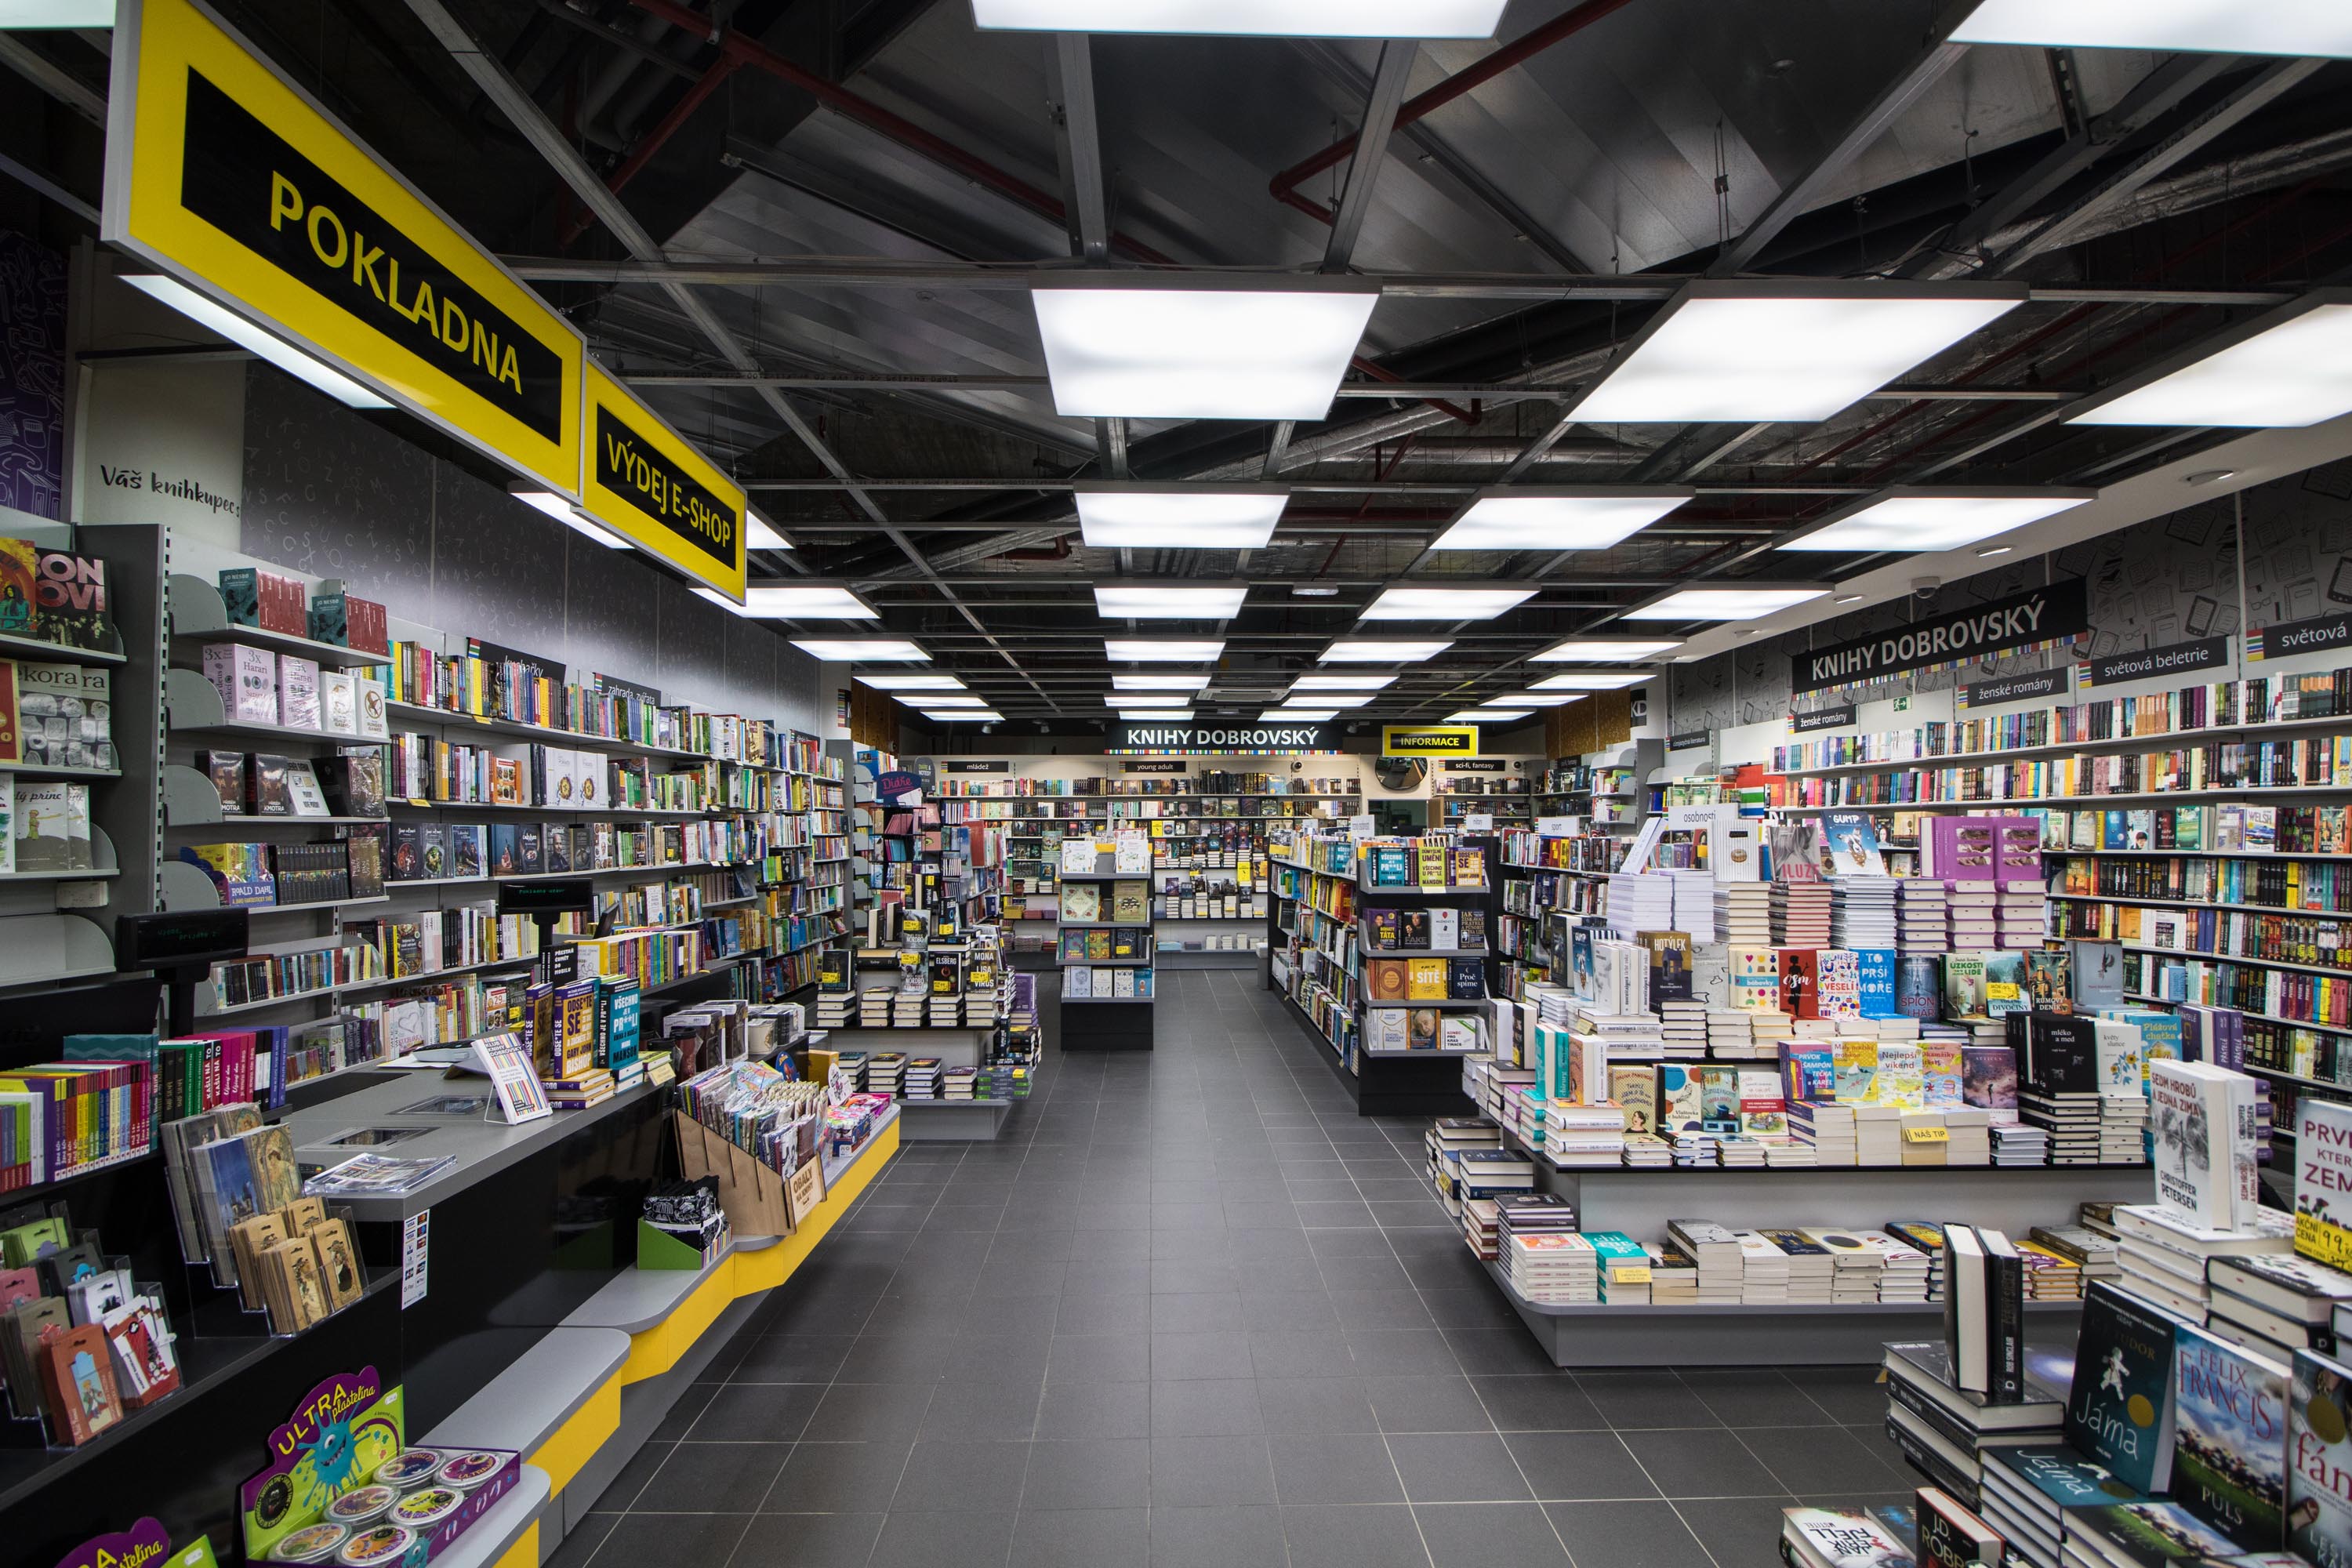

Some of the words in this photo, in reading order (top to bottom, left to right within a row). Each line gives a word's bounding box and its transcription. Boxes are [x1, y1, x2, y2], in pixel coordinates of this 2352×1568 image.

[270, 169, 522, 395] POKLADNA
[100, 464, 143, 490] Váš
[151, 471, 235, 514] knihkupec
[606, 430, 669, 517] VÝDEJ
[671, 493, 732, 550] E-SHOP
[1811, 643, 1878, 682] KNIHY
[1881, 600, 2045, 666] DOBROVSKÝ
[2281, 624, 2347, 649] světová
[205, 648, 223, 661] 3x
[248, 650, 263, 664] 3x
[243, 661, 268, 674] Harari
[2103, 656, 2152, 677] světová
[2154, 648, 2209, 671] beletrie
[608, 684, 636, 701] zahrada,
[1978, 682, 2016, 701] ženské
[2017, 677, 2053, 698] romány
[1800, 717, 1821, 728] ženské
[1821, 713, 1847, 725] romány
[1127, 729, 1192, 745] KNIHY
[1196, 726, 1319, 746] DOBROVSKÝ
[1400, 737, 1460, 746] INFORMACE
[1157, 762, 1174, 771] adult
[880, 773, 913, 790] Diáře
[29, 789, 62, 803] princ
[1683, 809, 1717, 823] osobnosti
[1832, 814, 1860, 824] GUMP
[1551, 822, 1563, 832] sport
[1422, 853, 1443, 862] UMĚNÍ
[1458, 858, 1469, 869] SE
[231, 886, 252, 897] ROALD
[255, 884, 274, 895] DAHL
[1653, 935, 1686, 953] HOTÝLEK
[974, 952, 994, 961] MONA
[1865, 953, 1883, 964] TO
[976, 964, 993, 974] LISA
[1861, 965, 1888, 978] PRŠÍ
[1417, 969, 1440, 984] SÍTĚ
[1746, 978, 1774, 987] bábovky
[1457, 979, 1479, 988] spíme
[1824, 980, 1855, 991] VESELÍ
[1858, 980, 1893, 993] MOŘE
[613, 993, 639, 1011] VŠECHNO
[525, 1019, 534, 1028] SE
[554, 1019, 562, 1028] SE
[567, 1011, 581, 1036] SE
[2143, 1022, 2178, 1032] Plážová
[2103, 1033, 2119, 1042] květy
[2145, 1030, 2176, 1040] chatka
[205, 1047, 212, 1060] TO
[215, 1045, 222, 1058] TO
[490, 1046, 523, 1058] DOBROVSKÝ
[566, 1047, 579, 1059] GARY
[1882, 1050, 1918, 1062] Nejlepší
[565, 1053, 593, 1075] BISHOP
[1802, 1060, 1832, 1069] ŠAMPÓN
[1885, 1060, 1915, 1069] víkend
[1812, 1069, 1832, 1078] TEČKA
[212, 1073, 221, 1096] KAŠLI
[1812, 1078, 1833, 1087] KAREL
[2151, 1072, 2169, 1091] SEDM
[2169, 1081, 2196, 1099] HROBŮ
[2157, 1092, 2179, 1109] JEDNA
[2179, 1098, 2200, 1117] ZIMA
[1914, 1130, 1932, 1138] NÁŠ
[1932, 1129, 1946, 1138] TIP
[793, 1166, 813, 1194] OBALY
[2160, 1169, 2198, 1196] CHRISTOFFER
[2161, 1182, 2198, 1212] PETERSEN
[2296, 1228, 2317, 1244] CENA
[2005, 1336, 2014, 1361] SINCLAIR
[2005, 1362, 2014, 1374] ROB
[2199, 1347, 2247, 1388] FELIX
[2179, 1349, 2273, 1441] FRANCIS
[331, 1384, 376, 1425] plastelína
[278, 1382, 347, 1456] ULTRA
[2075, 1391, 2140, 1461] Jáma
[2201, 1486, 2244, 1526] PULS
[1809, 1527, 1871, 1539] FJELL
[1933, 1513, 1951, 1542] J.D.
[1828, 1539, 1873, 1548] ERIK
